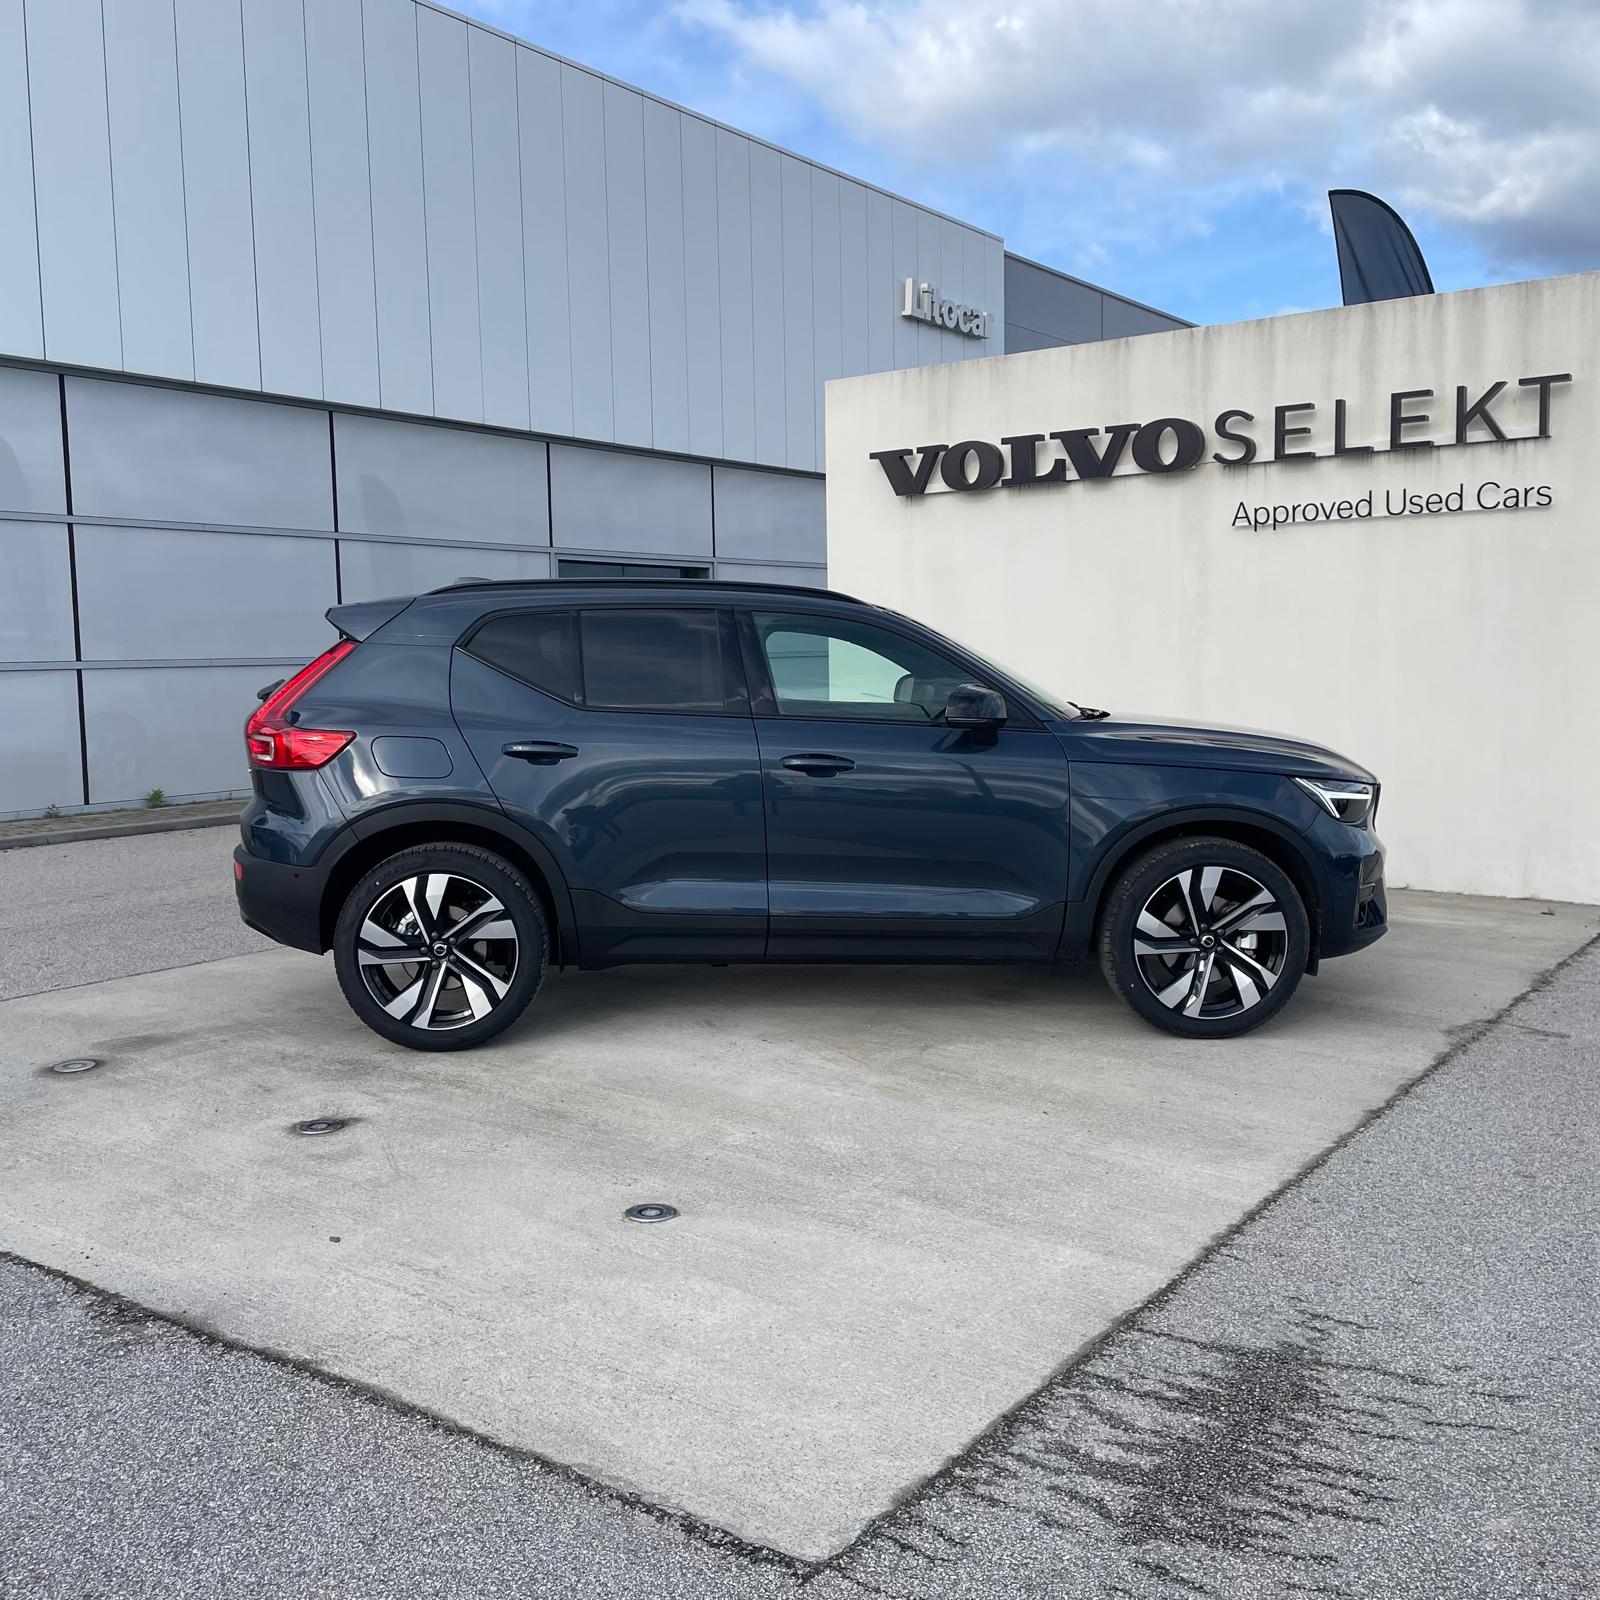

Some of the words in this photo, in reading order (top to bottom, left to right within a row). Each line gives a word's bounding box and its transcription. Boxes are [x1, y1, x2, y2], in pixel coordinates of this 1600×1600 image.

[902, 277, 994, 339] Litocar
[869, 416, 1204, 496] VOLVO
[1213, 373, 1572, 466] SELEKT
[1231, 490, 1373, 532] Approved
[1385, 483, 1463, 516] Used
[1476, 481, 1553, 511] Cars
